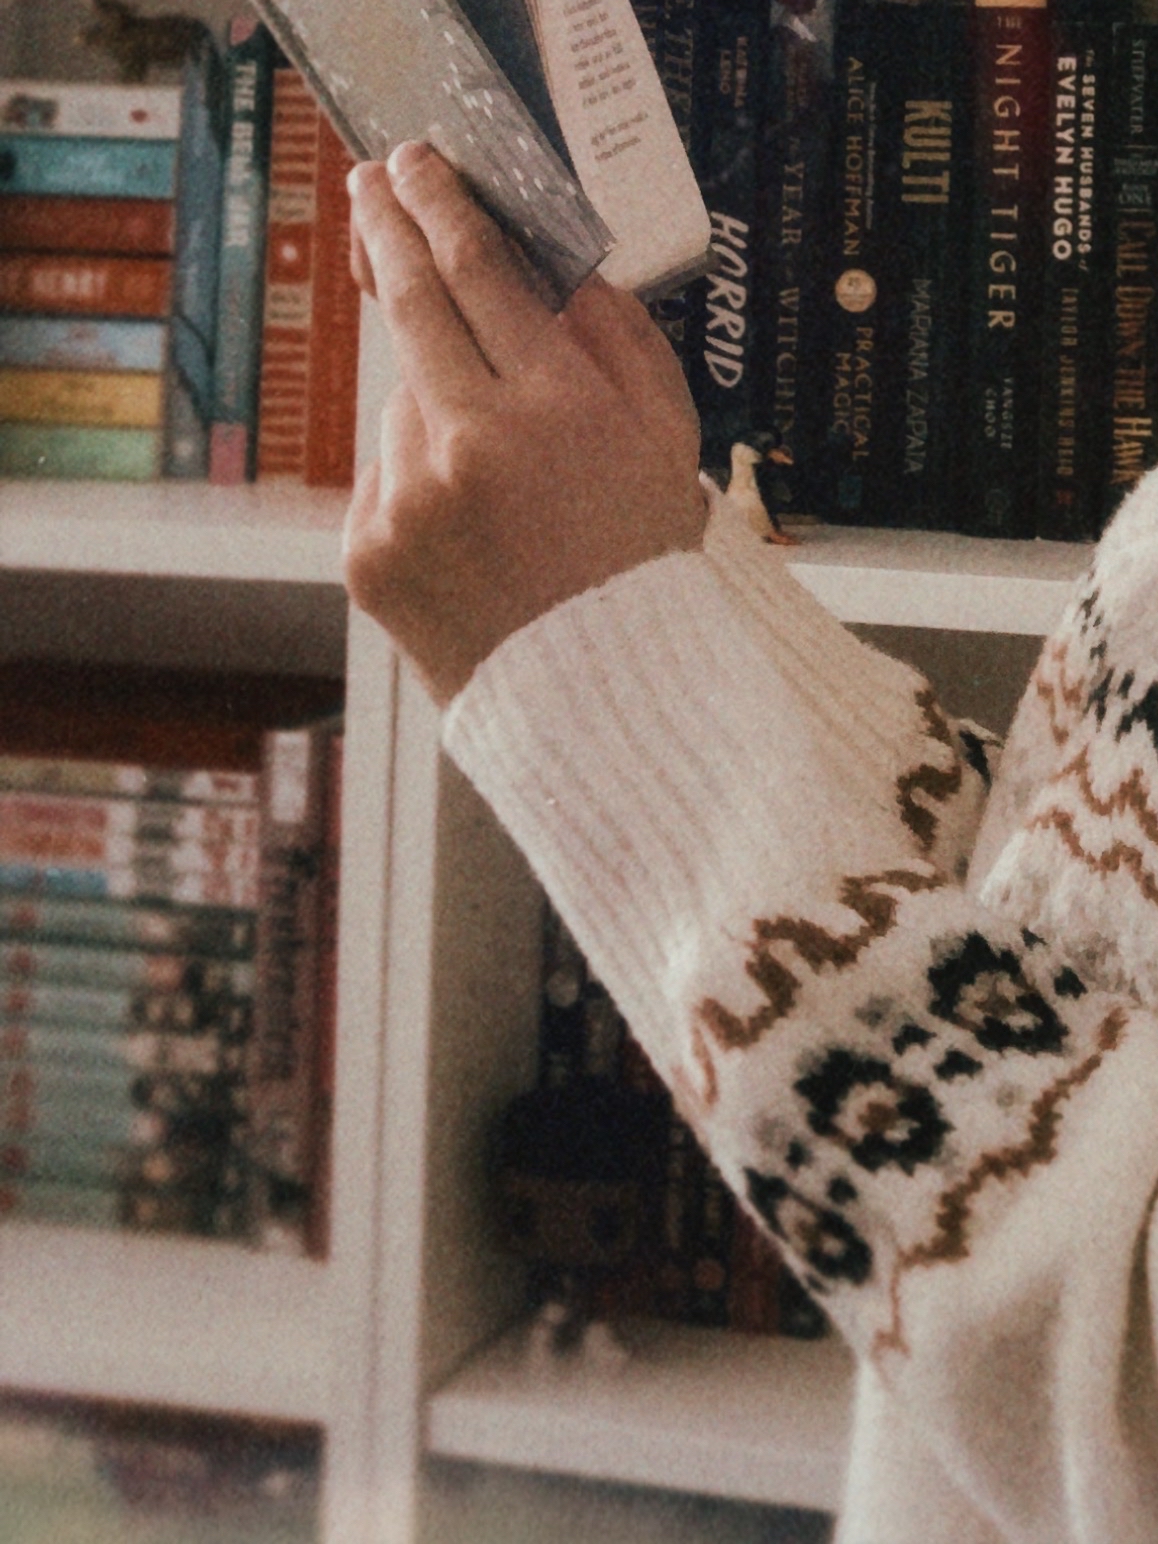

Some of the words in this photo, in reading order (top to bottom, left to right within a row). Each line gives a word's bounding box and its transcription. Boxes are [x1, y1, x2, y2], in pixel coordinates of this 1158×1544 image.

[233, 63, 257, 110] THE
[846, 56, 866, 123] ALICE
[991, 42, 1021, 182] NIGHT
[1054, 56, 1077, 165] EVELYN
[1080, 74, 1096, 137] SEVEN
[900, 99, 953, 206] KULTI
[781, 161, 805, 246] YEAR
[842, 135, 864, 256] HOFFMAN
[1051, 176, 1075, 261] HUGO
[1076, 147, 1094, 253] HUSBANDS
[987, 206, 1019, 331] TIGER
[1116, 221, 1156, 277] CALL
[705, 211, 749, 388] HORRID
[908, 278, 932, 382] MARIANA
[1115, 286, 1155, 358] DOWN
[832, 352, 852, 434] MAGIC
[852, 325, 875, 462] PRACTICAL
[984, 388, 997, 439] CHOO
[1113, 368, 1147, 409] THE
[903, 389, 930, 474] ZAPATA
